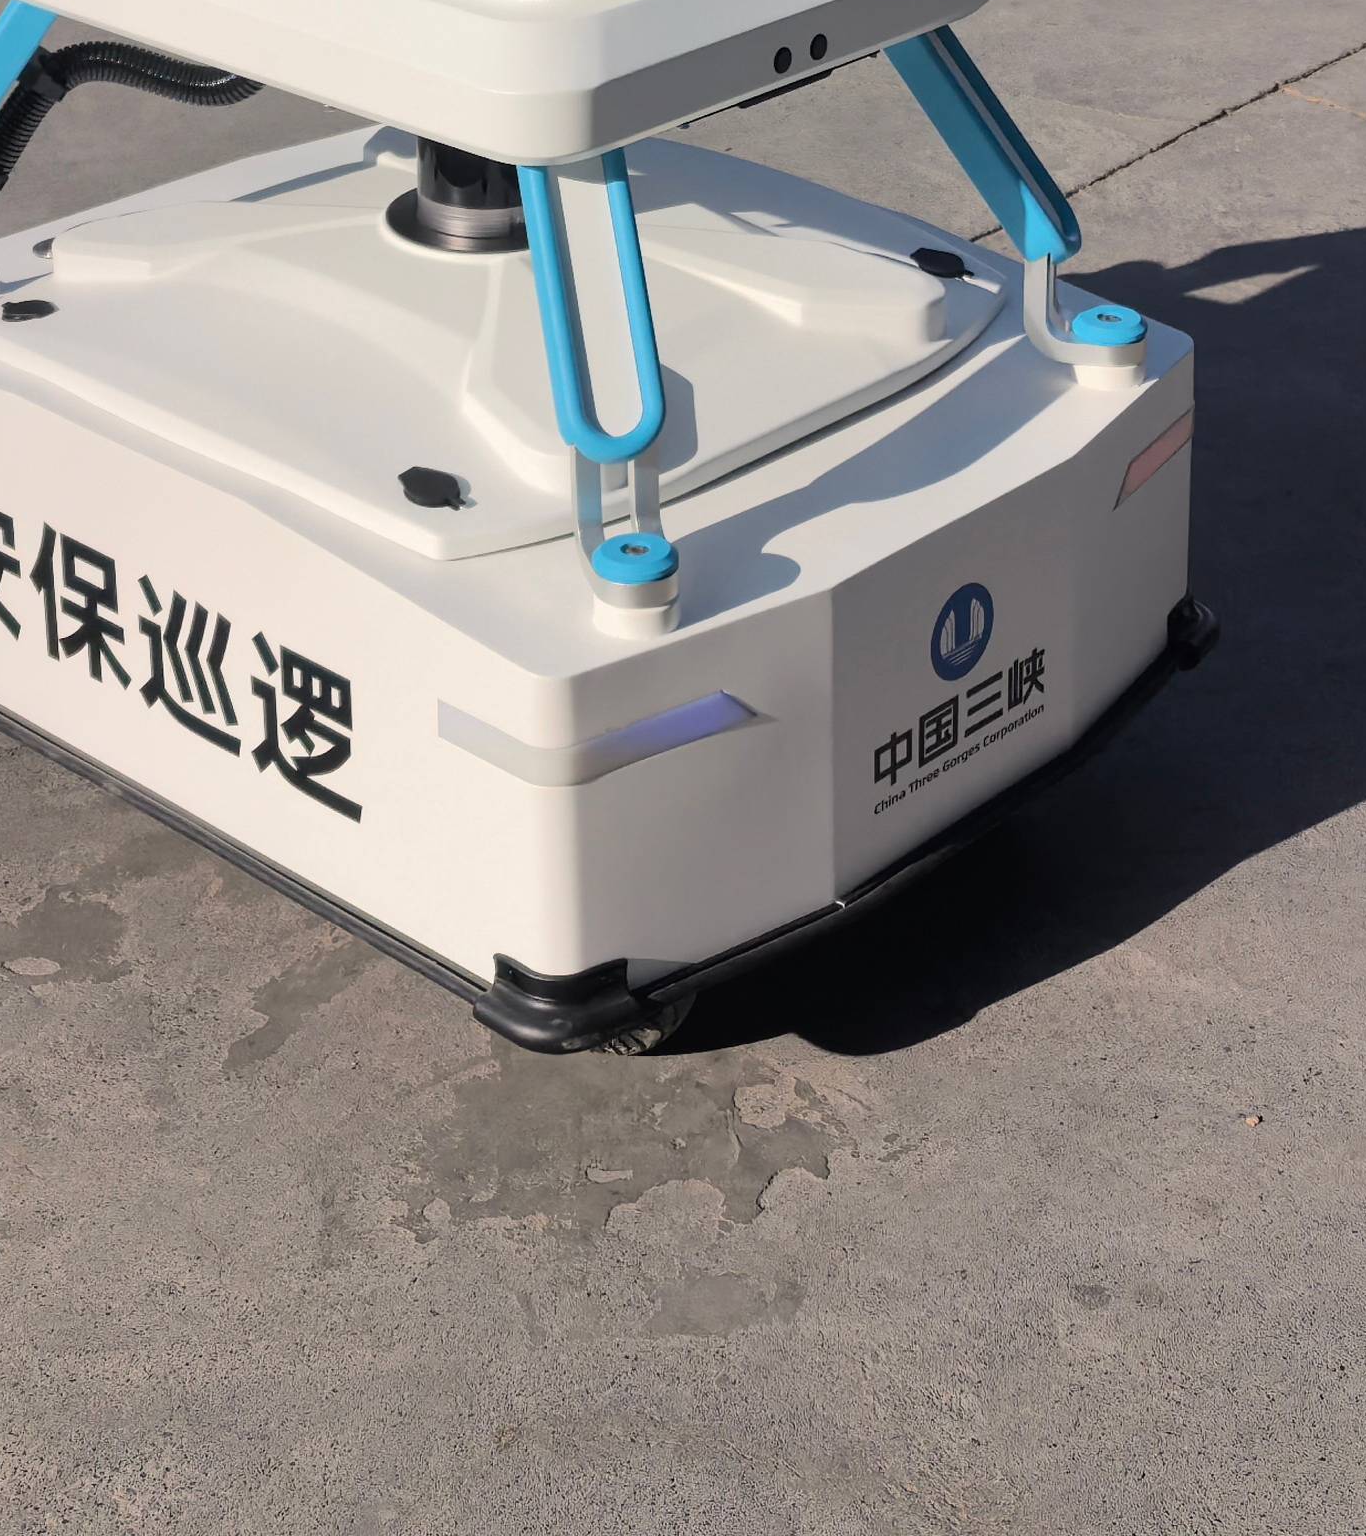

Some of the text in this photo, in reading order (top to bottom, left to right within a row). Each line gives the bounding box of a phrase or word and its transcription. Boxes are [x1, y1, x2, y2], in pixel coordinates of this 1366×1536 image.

[874, 648, 1045, 785] 中国三峡
[874, 704, 1045, 815] China Three Gorges Corporation
